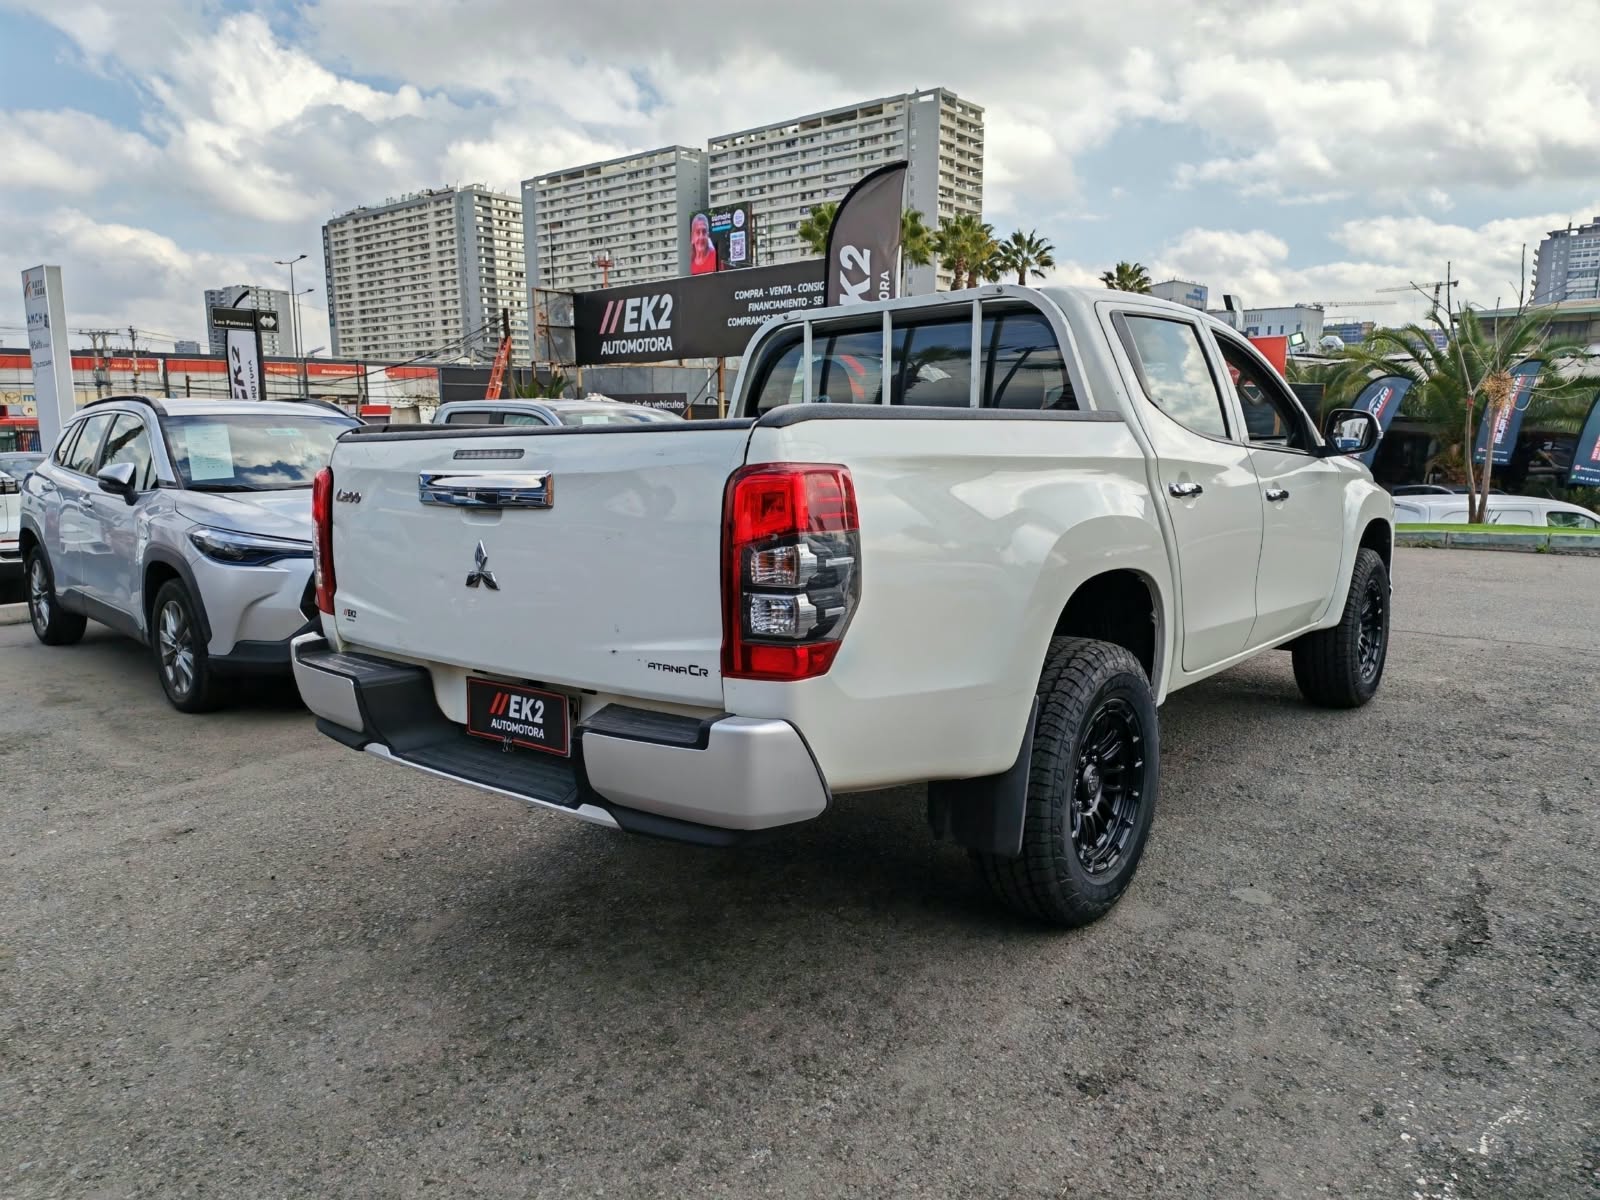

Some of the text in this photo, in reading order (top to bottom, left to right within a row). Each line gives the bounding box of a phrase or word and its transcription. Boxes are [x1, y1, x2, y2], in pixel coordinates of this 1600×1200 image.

[734, 288, 764, 300] COMPRA
[769, 285, 793, 296] VENTA
[748, 297, 807, 312] FINANCIAMIENTO
[600, 335, 673, 356] AUTOMOTORA
[652, 399, 685, 409] vehículos
[490, 718, 545, 739] AUTOMOTORA
